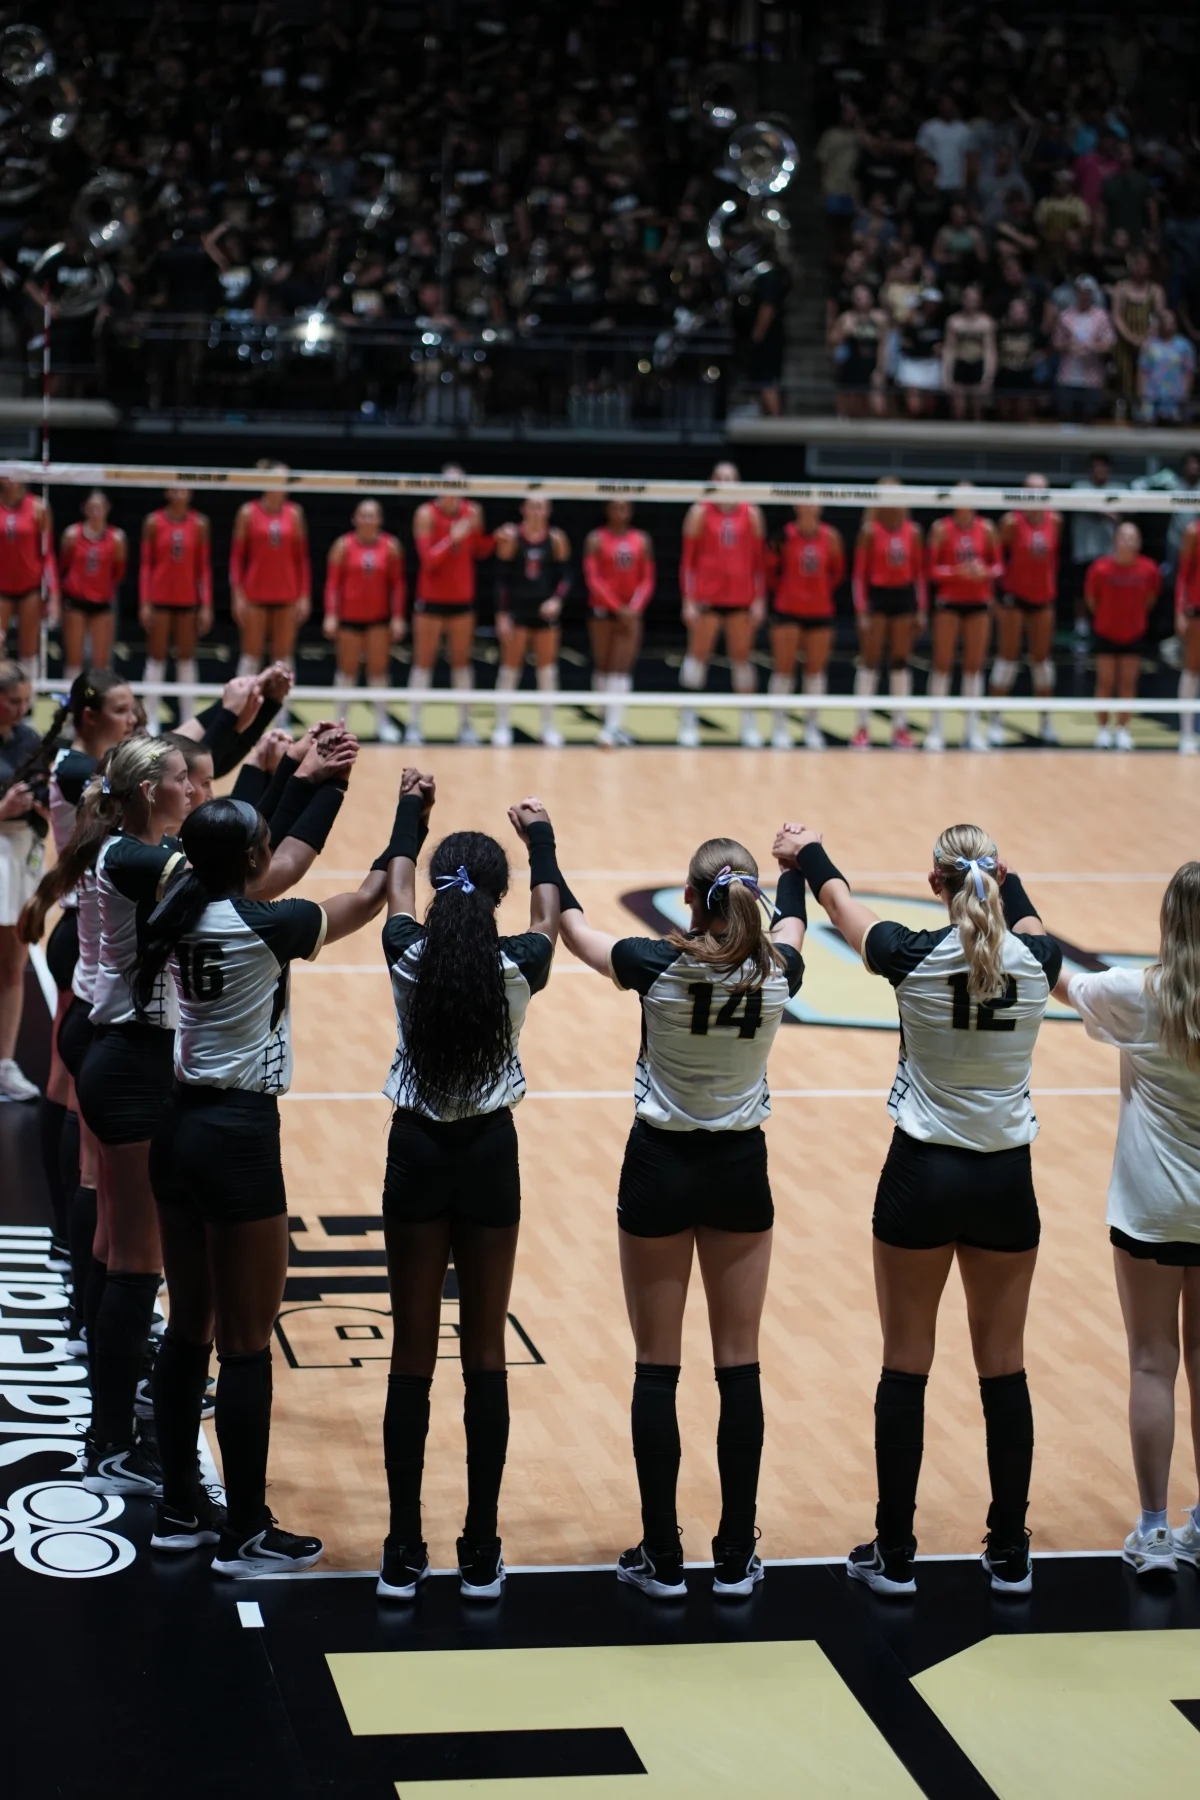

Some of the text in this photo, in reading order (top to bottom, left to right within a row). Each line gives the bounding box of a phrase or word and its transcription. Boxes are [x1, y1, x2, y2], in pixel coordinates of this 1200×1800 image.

[175, 942, 225, 1001] 16
[687, 981, 764, 1040] 14
[947, 973, 1019, 1032] 12
